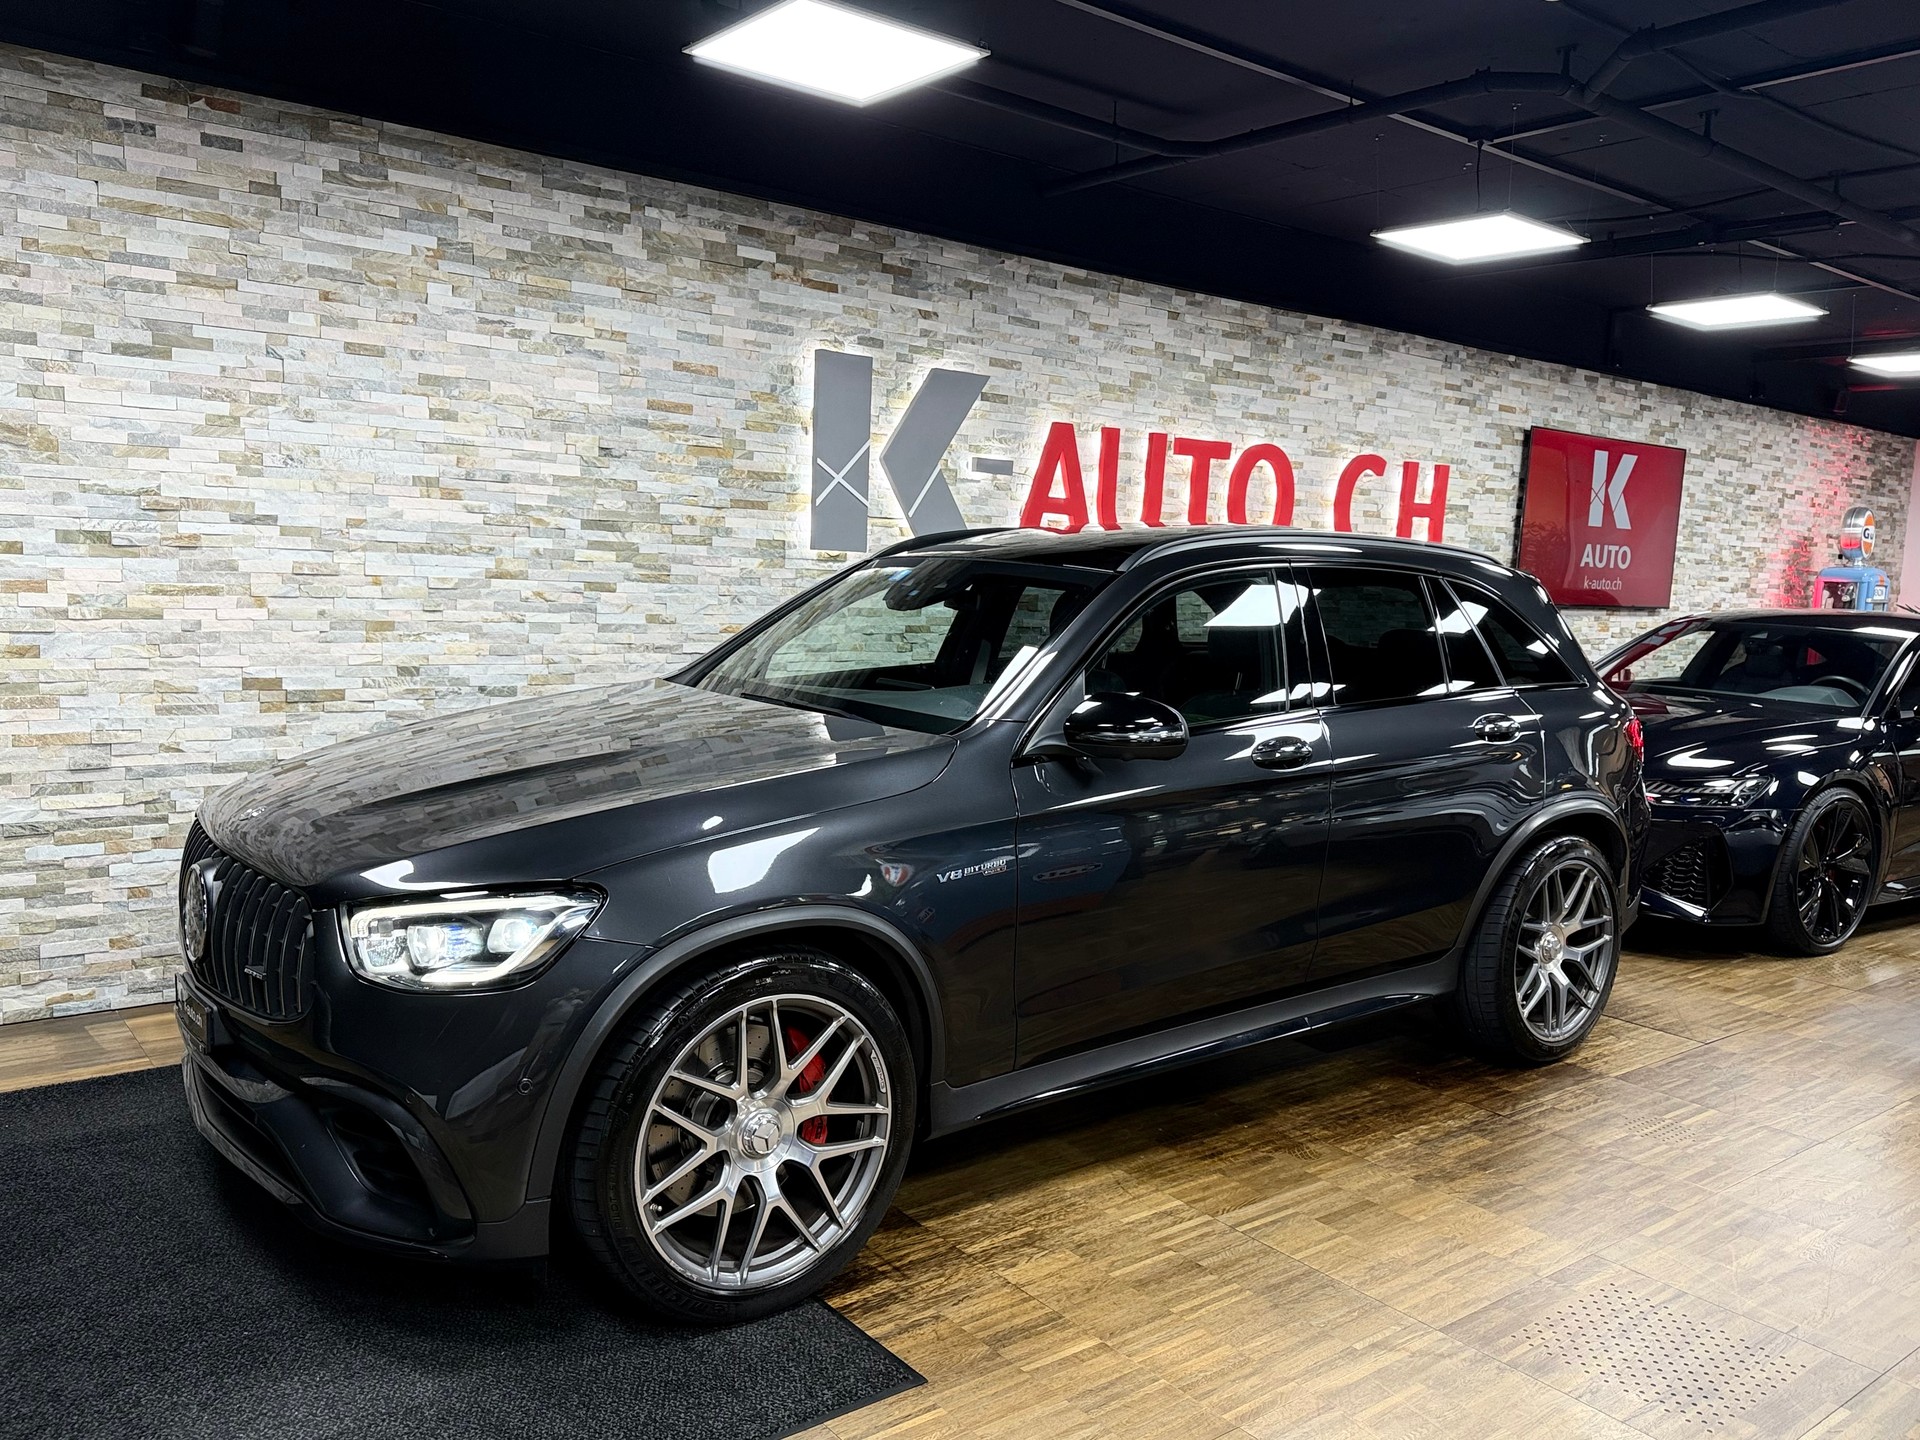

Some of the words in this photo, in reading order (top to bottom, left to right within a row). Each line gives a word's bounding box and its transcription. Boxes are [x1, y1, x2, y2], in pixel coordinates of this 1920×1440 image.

[1587, 450, 1639, 530] K
[1580, 542, 1632, 570] AUTO
[1583, 575, 1622, 591] k-auto.ch
[936, 869, 962, 884] V8
